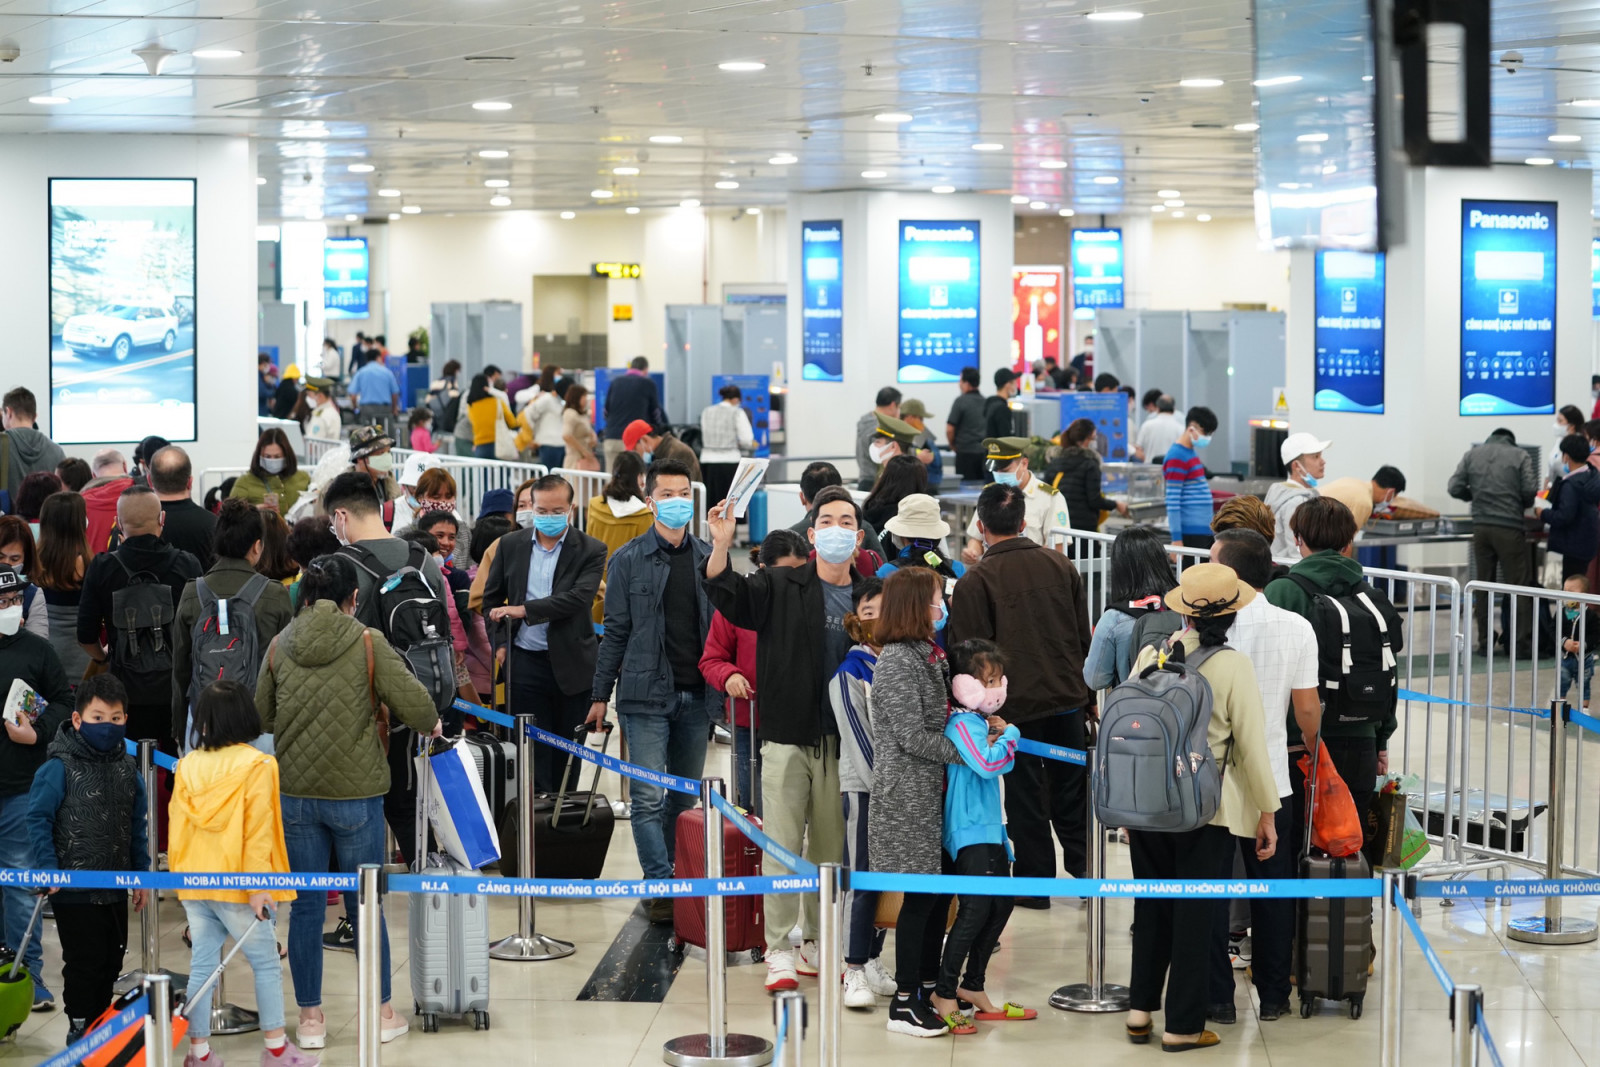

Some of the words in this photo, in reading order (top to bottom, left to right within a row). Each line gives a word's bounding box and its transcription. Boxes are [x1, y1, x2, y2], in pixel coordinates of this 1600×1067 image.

[1470, 210, 1549, 230] Panasonic
[632, 768, 661, 782] INTERNATIONAL
[660, 775, 677, 787] AIRPORT
[17, 869, 30, 882] TẾ
[32, 871, 51, 885] NỘI
[53, 872, 71, 884] BÀI
[115, 875, 141, 885] N.I.A
[184, 876, 220, 886] NOIBAI
[222, 876, 308, 887] INTERNATIONAL
[310, 877, 356, 888] AIRPORT
[421, 881, 449, 892] N.I.A
[477, 880, 511, 894] CẢNG
[514, 882, 547, 895] HÀNG
[551, 882, 592, 895] KHÔNG
[595, 880, 629, 895] QUỐC
[631, 880, 646, 894] TẾ
[649, 881, 670, 896] NỘI
[672, 881, 693, 893] BÀI
[717, 881, 746, 891] N.I.A
[772, 879, 813, 889] NOIBAI
[1099, 883, 1117, 893] AN
[1119, 883, 1147, 893] NINH
[1150, 882, 1183, 893] HÀNG
[1185, 881, 1225, 893] KHÔNG
[1227, 882, 1247, 895] NỘI
[1249, 882, 1269, 893] BÀI
[1441, 885, 1468, 895] N.I.A
[1494, 883, 1526, 895] CẢNG
[1529, 883, 1560, 895] HÀNG
